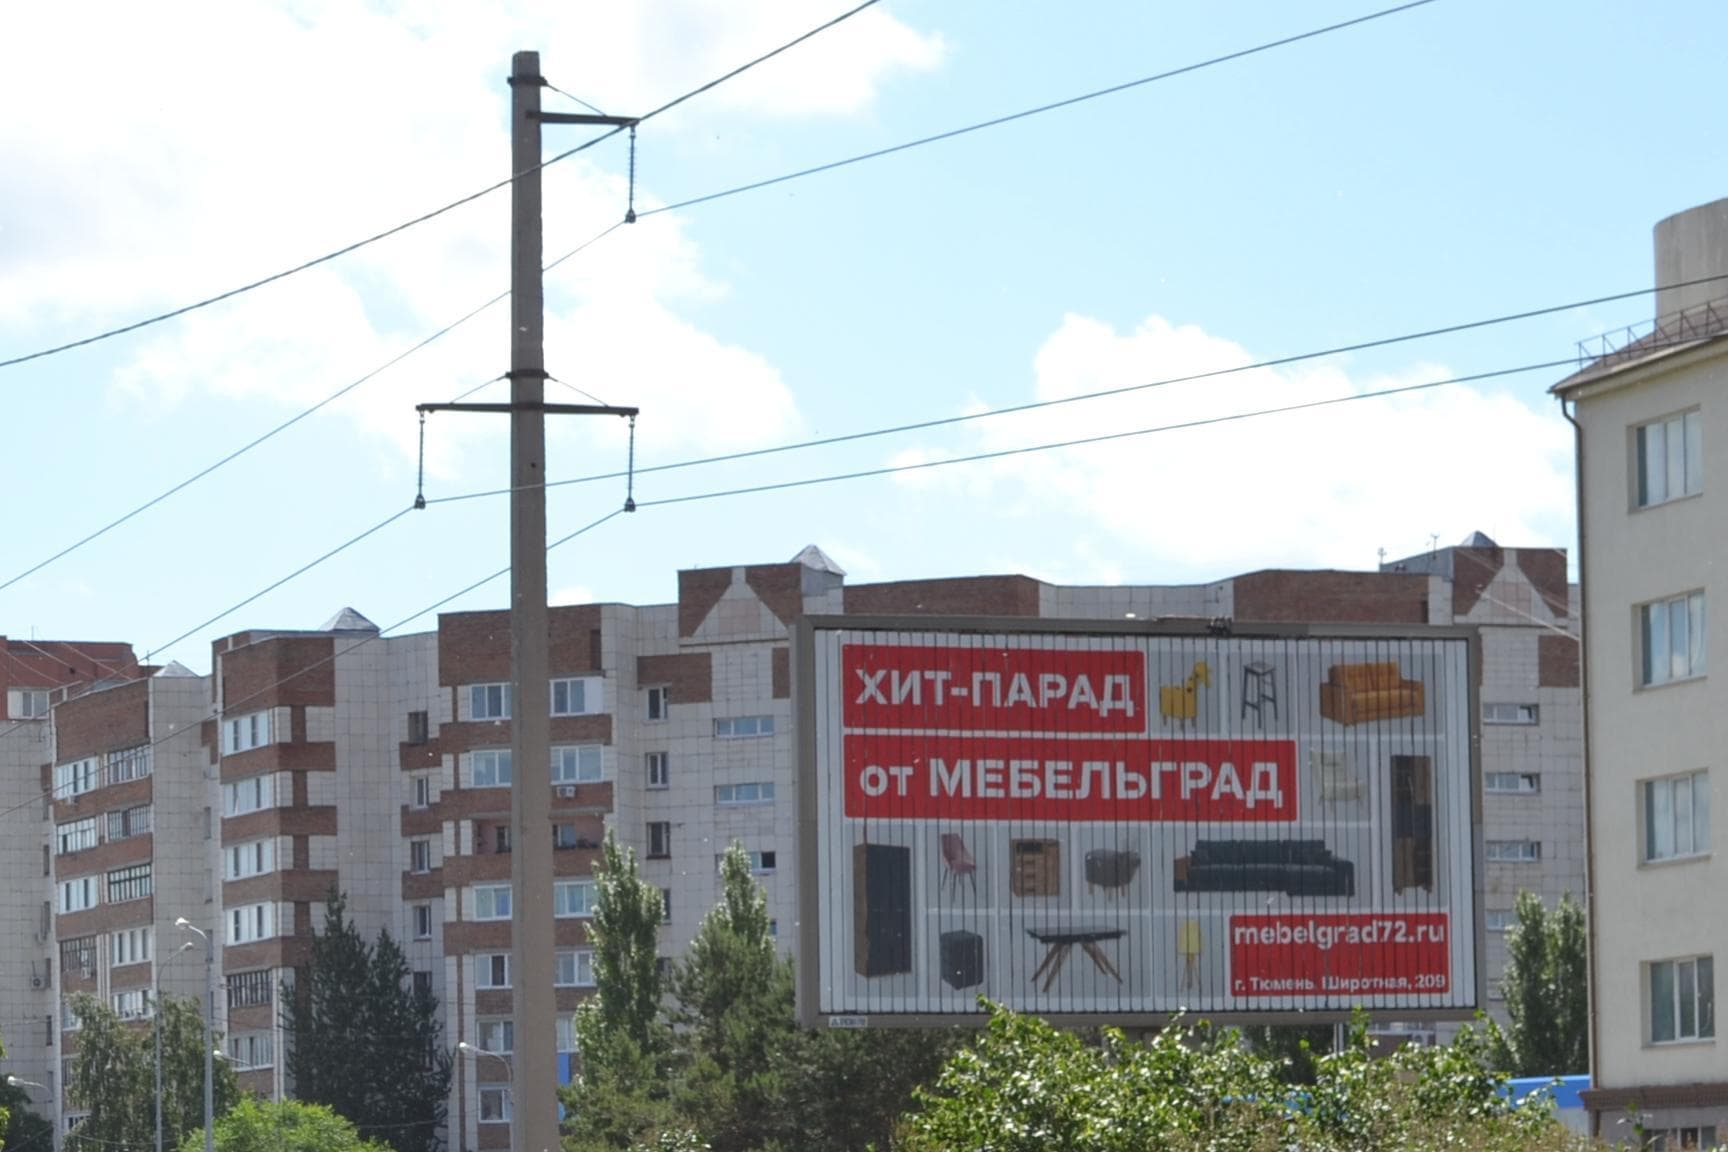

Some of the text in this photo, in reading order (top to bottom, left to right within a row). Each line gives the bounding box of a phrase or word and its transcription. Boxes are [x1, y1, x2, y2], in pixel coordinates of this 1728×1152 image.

[854, 668, 1135, 718] ХИТ-ПАРАД
[859, 757, 1284, 809] от МЕБЕЛЬГРАД
[1234, 919, 1445, 949] mebelgrad72.ru
[1414, 974, 1446, 989] 209
